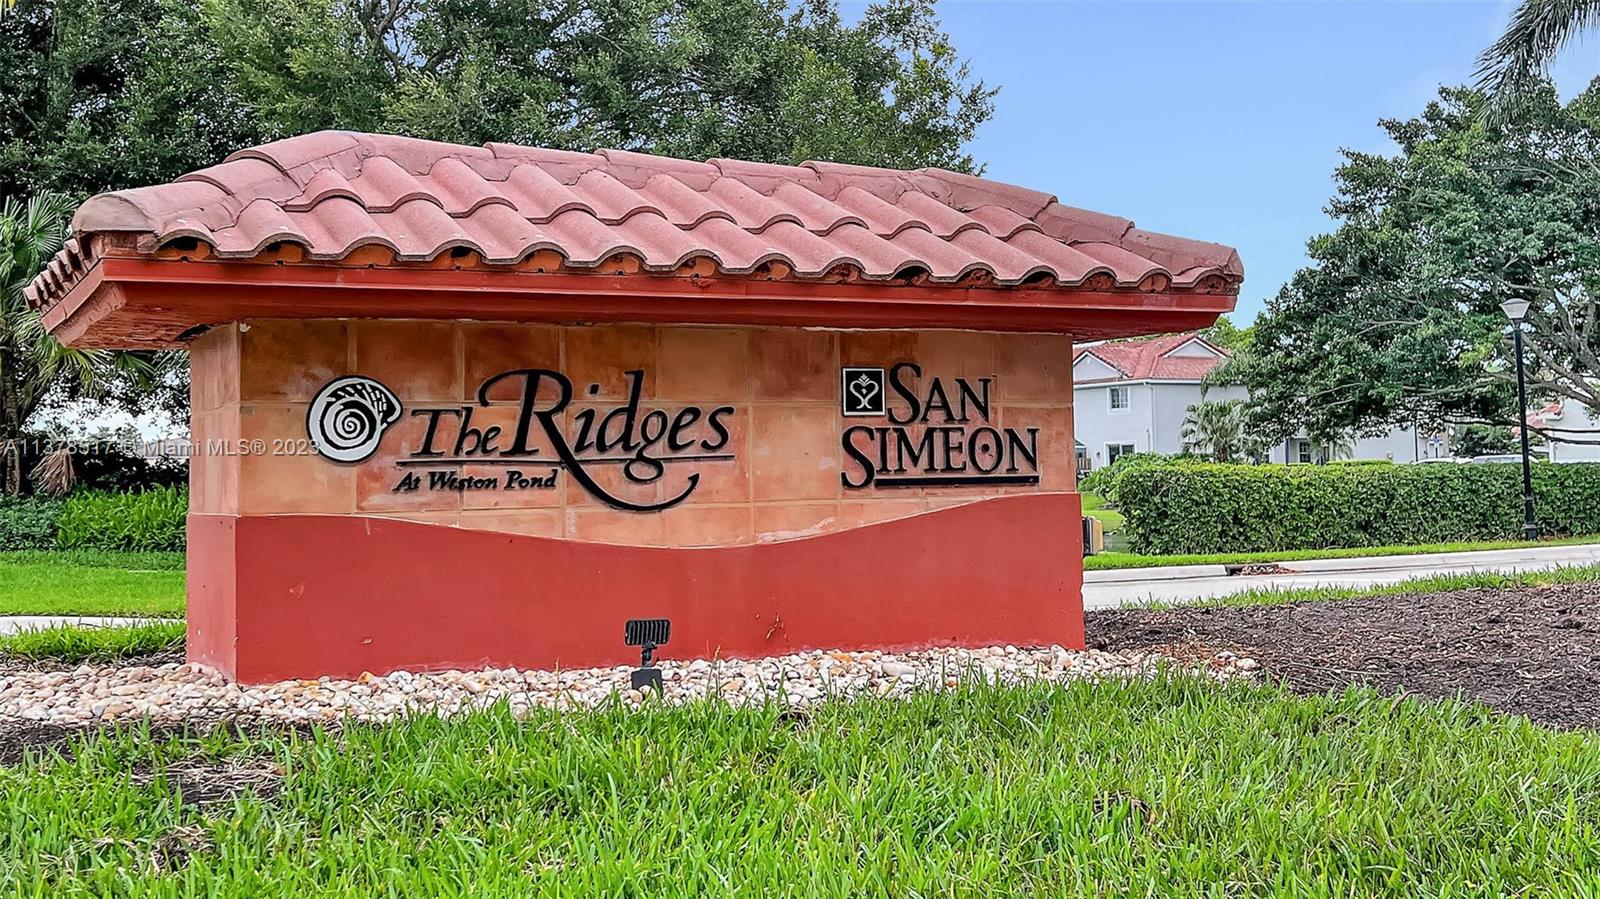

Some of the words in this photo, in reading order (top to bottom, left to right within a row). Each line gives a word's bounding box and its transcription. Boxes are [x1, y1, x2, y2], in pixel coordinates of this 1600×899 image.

[887, 362, 993, 425] SAN
[410, 405, 502, 457] The
[478, 368, 736, 512] Ridges
[841, 424, 1040, 489] SIMEON
[392, 471, 421, 491] At
[428, 470, 498, 491] Weston
[503, 469, 558, 489] Pond
